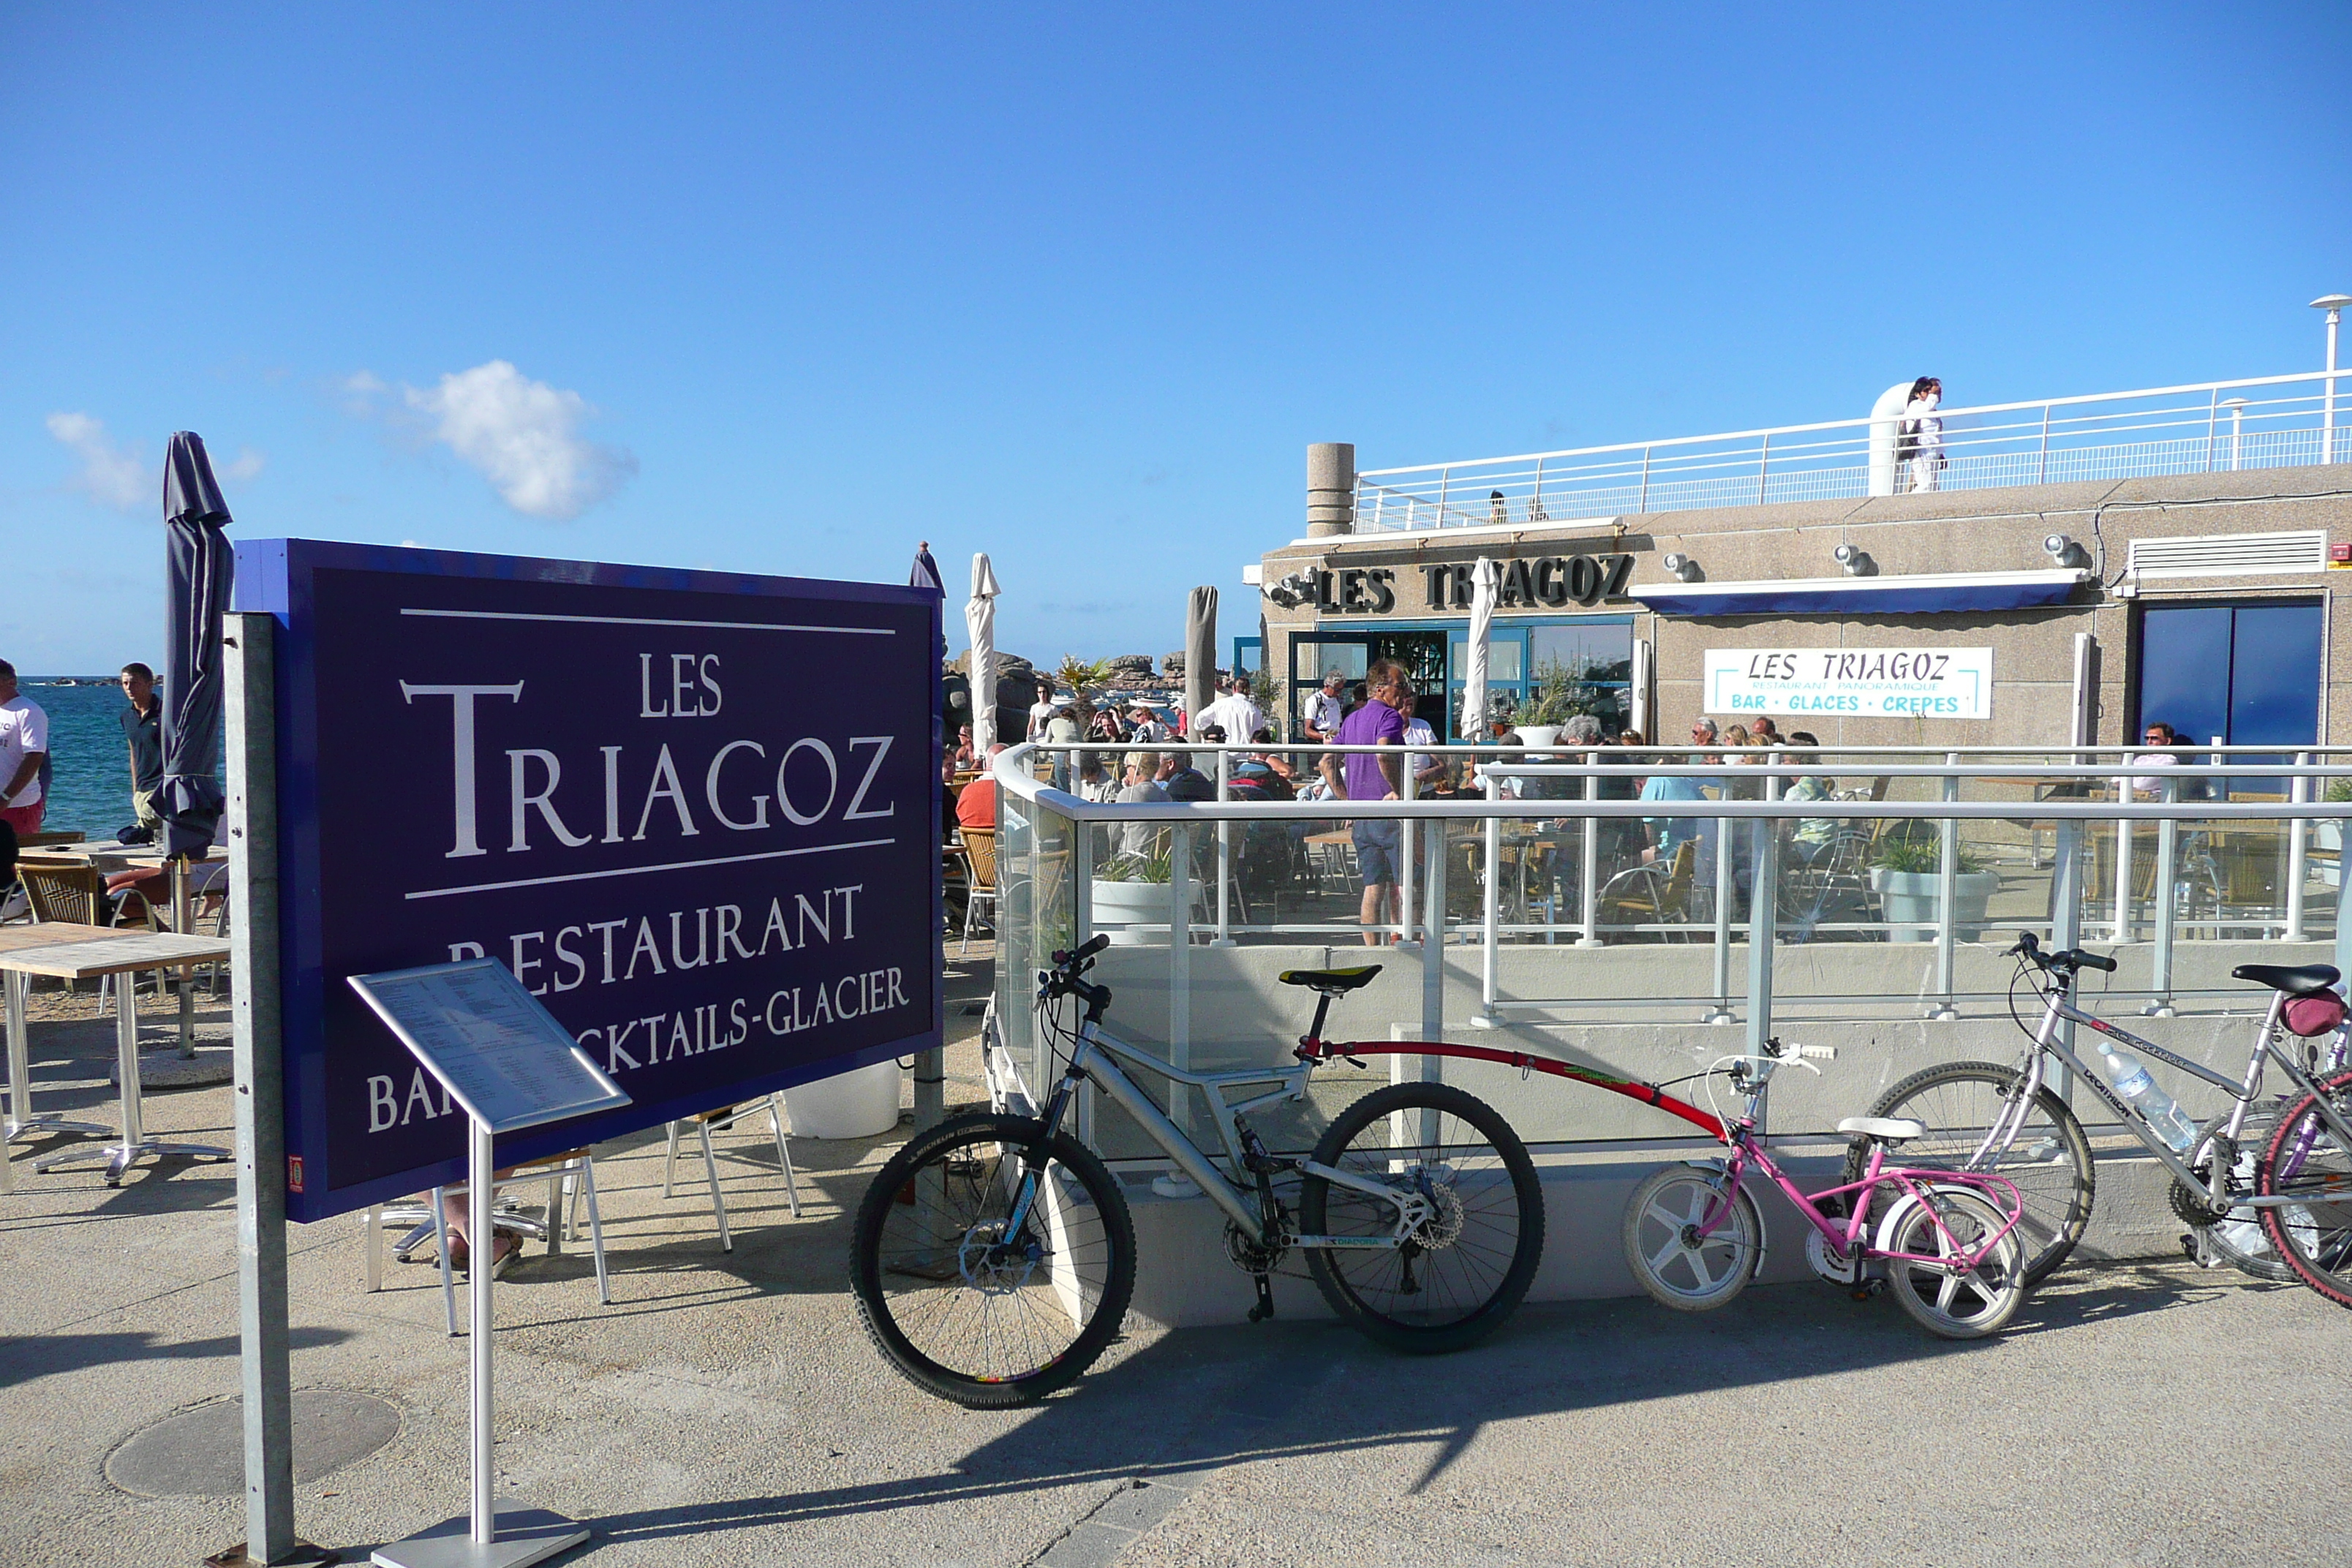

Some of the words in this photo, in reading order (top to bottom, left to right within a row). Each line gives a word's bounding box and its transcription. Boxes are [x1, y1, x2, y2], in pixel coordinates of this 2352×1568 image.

[1314, 568, 1390, 610] LES
[1419, 554, 1630, 606] TRAGOZ
[639, 653, 723, 718] LES
[1748, 653, 1798, 680] LES
[1823, 652, 1950, 681] TRIAGOZ
[1752, 682, 1828, 690] RESTAURANT
[1838, 682, 1939, 691] PANORAMIQUE
[1732, 694, 1766, 709] BAR
[1789, 696, 1859, 711] GLACES
[1882, 696, 1959, 712] CREPES
[399, 679, 894, 859] TRIAGOZ
[367, 1066, 453, 1134] BA
[2084, 1068, 2132, 1118] DECATHLON
[916, 1131, 955, 1157] MICHELIN
